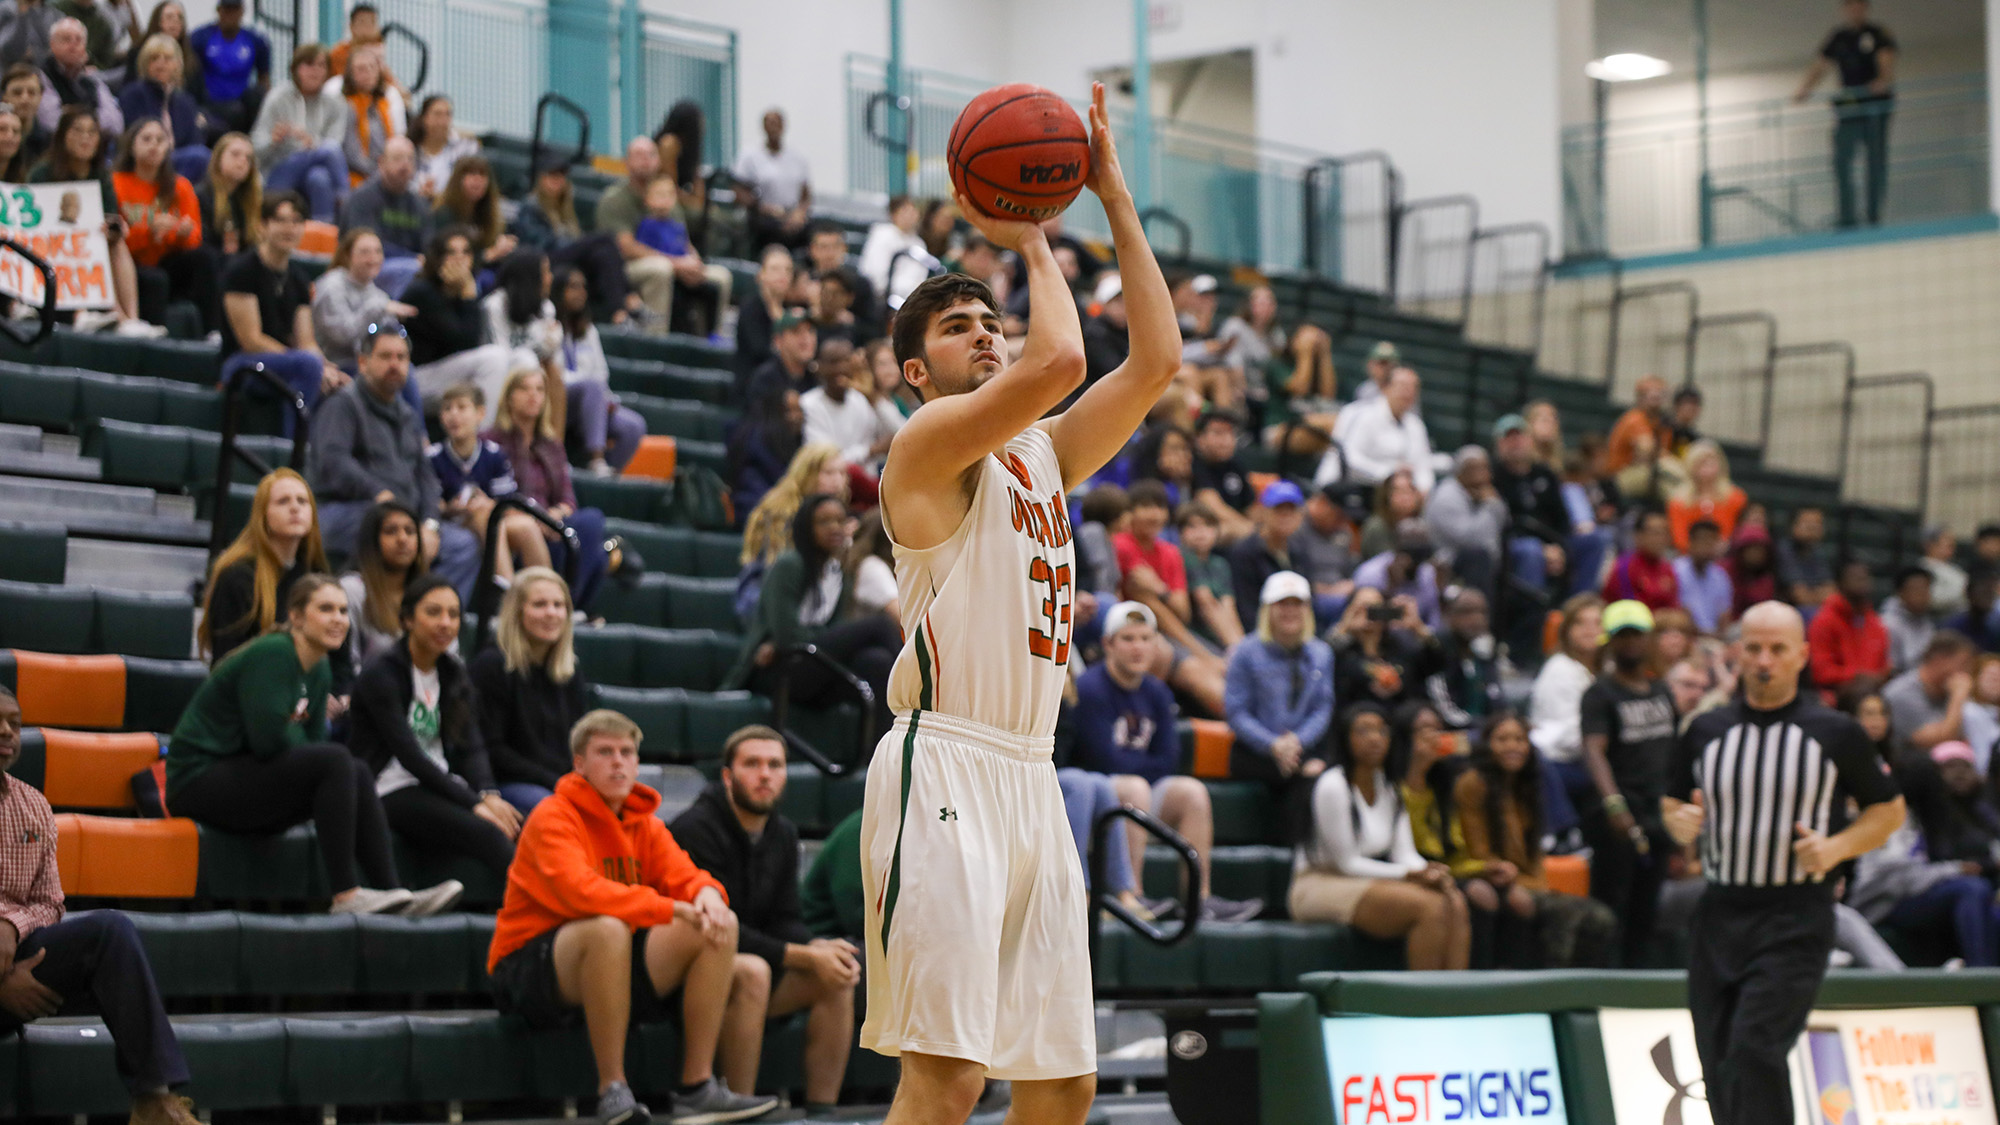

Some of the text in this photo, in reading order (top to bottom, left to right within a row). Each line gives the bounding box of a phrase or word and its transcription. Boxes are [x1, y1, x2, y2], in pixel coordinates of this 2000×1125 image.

[1020, 160, 1082, 184] NCAA
[1028, 556, 1071, 666] 33
[1855, 1027, 1936, 1067] Follow
[1864, 1073, 1910, 1112] The
